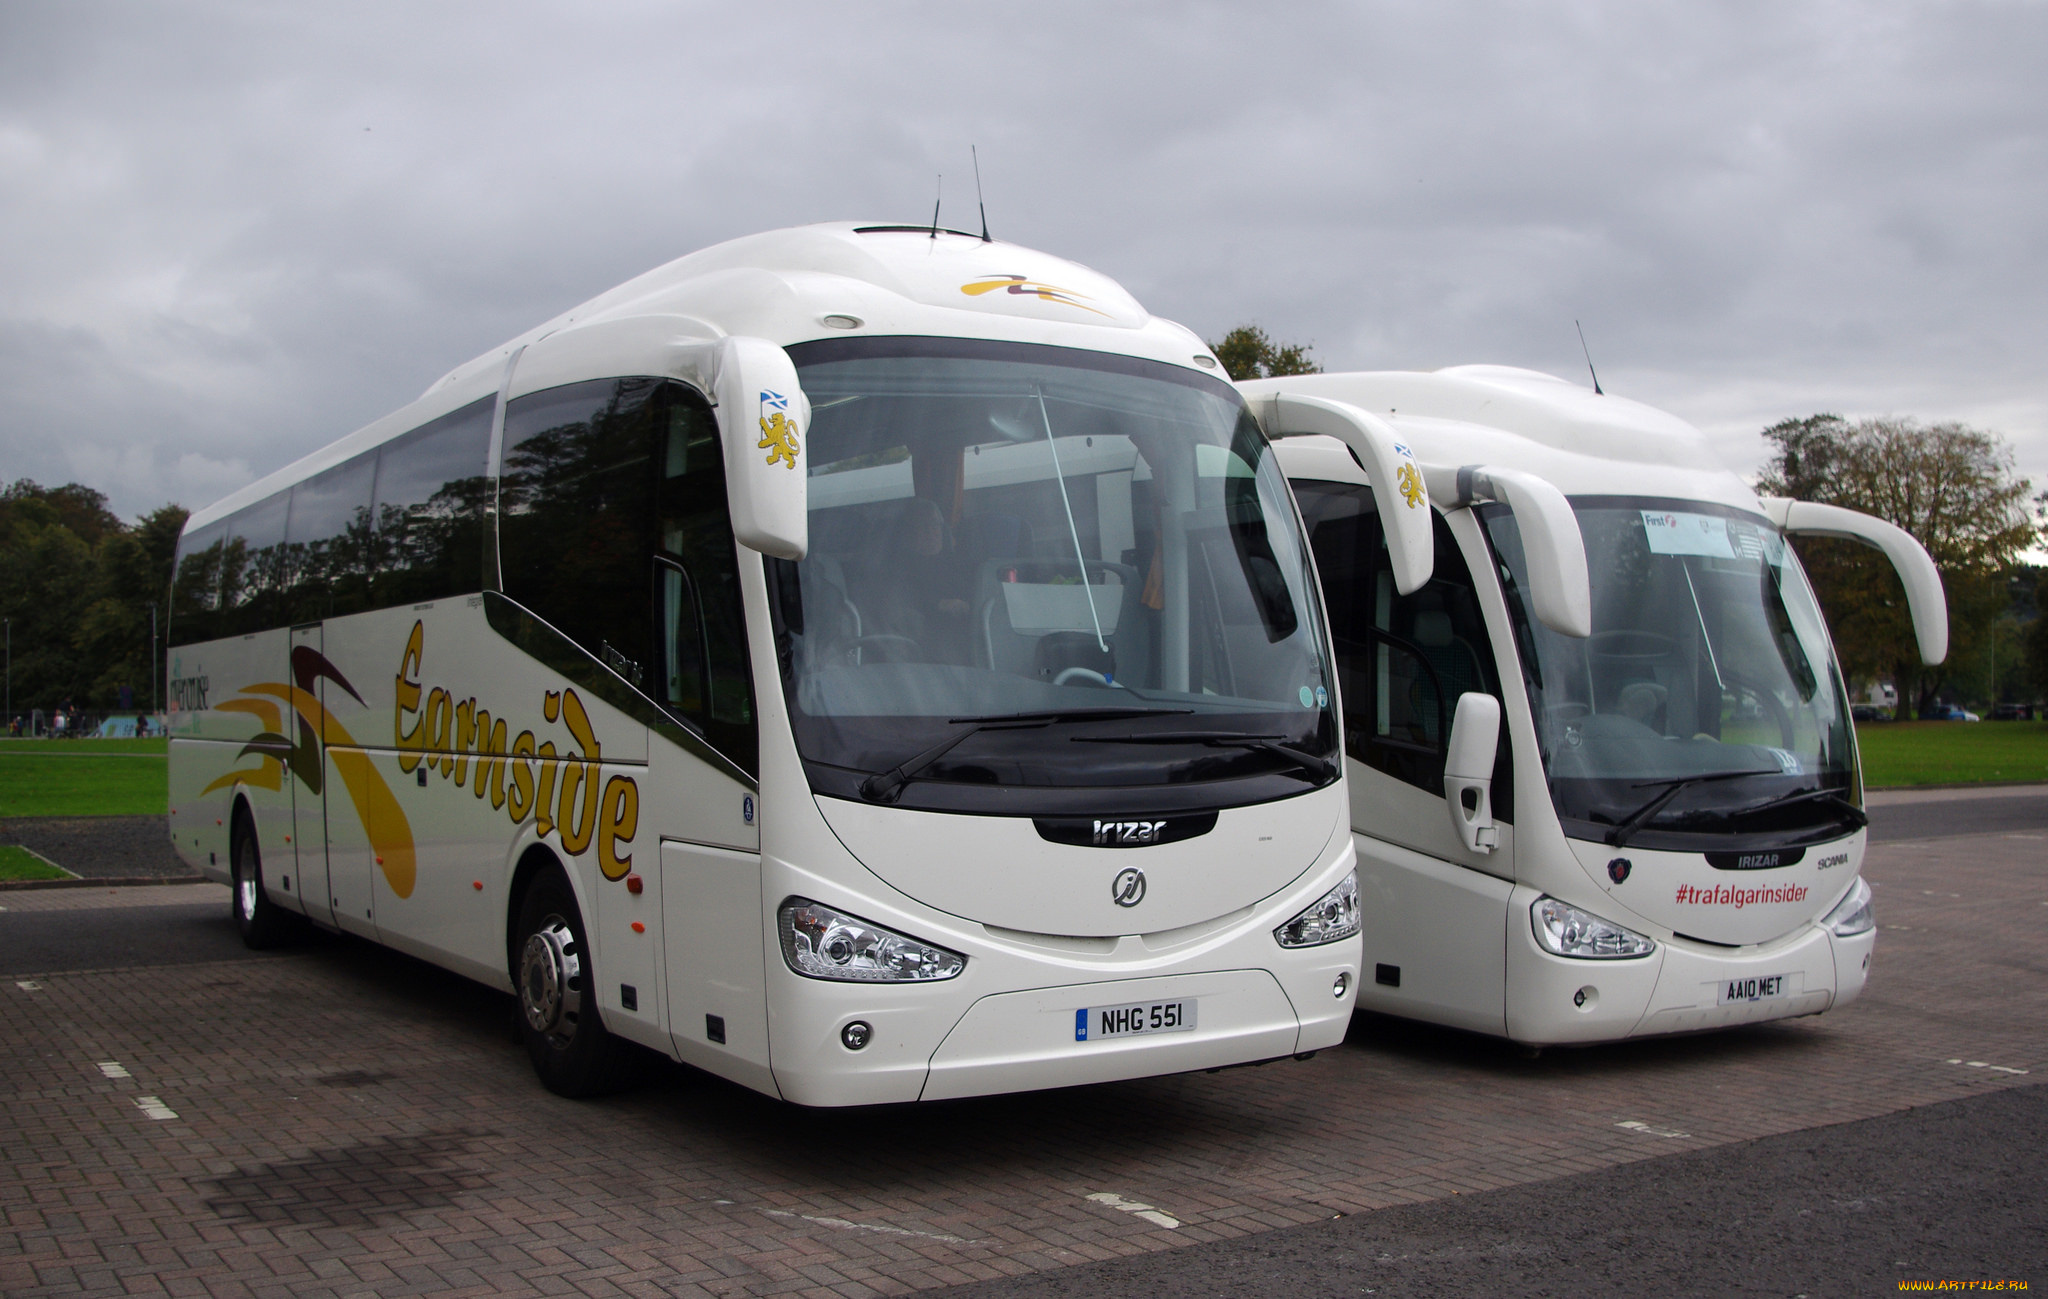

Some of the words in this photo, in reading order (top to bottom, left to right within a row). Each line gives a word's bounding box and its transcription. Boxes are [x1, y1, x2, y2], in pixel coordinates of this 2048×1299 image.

[1645, 515, 1665, 526] First
[395, 619, 639, 882] Earnside
[1093, 820, 1167, 844] Irizar
[1738, 854, 1779, 868] IRIZAR
[1818, 853, 1848, 870] SCANIA
[1676, 883, 1808, 909] #trafalgarinsider
[1759, 976, 1782, 996] MET
[1102, 1008, 1143, 1034] NHG
[1150, 1003, 1182, 1029] 551
